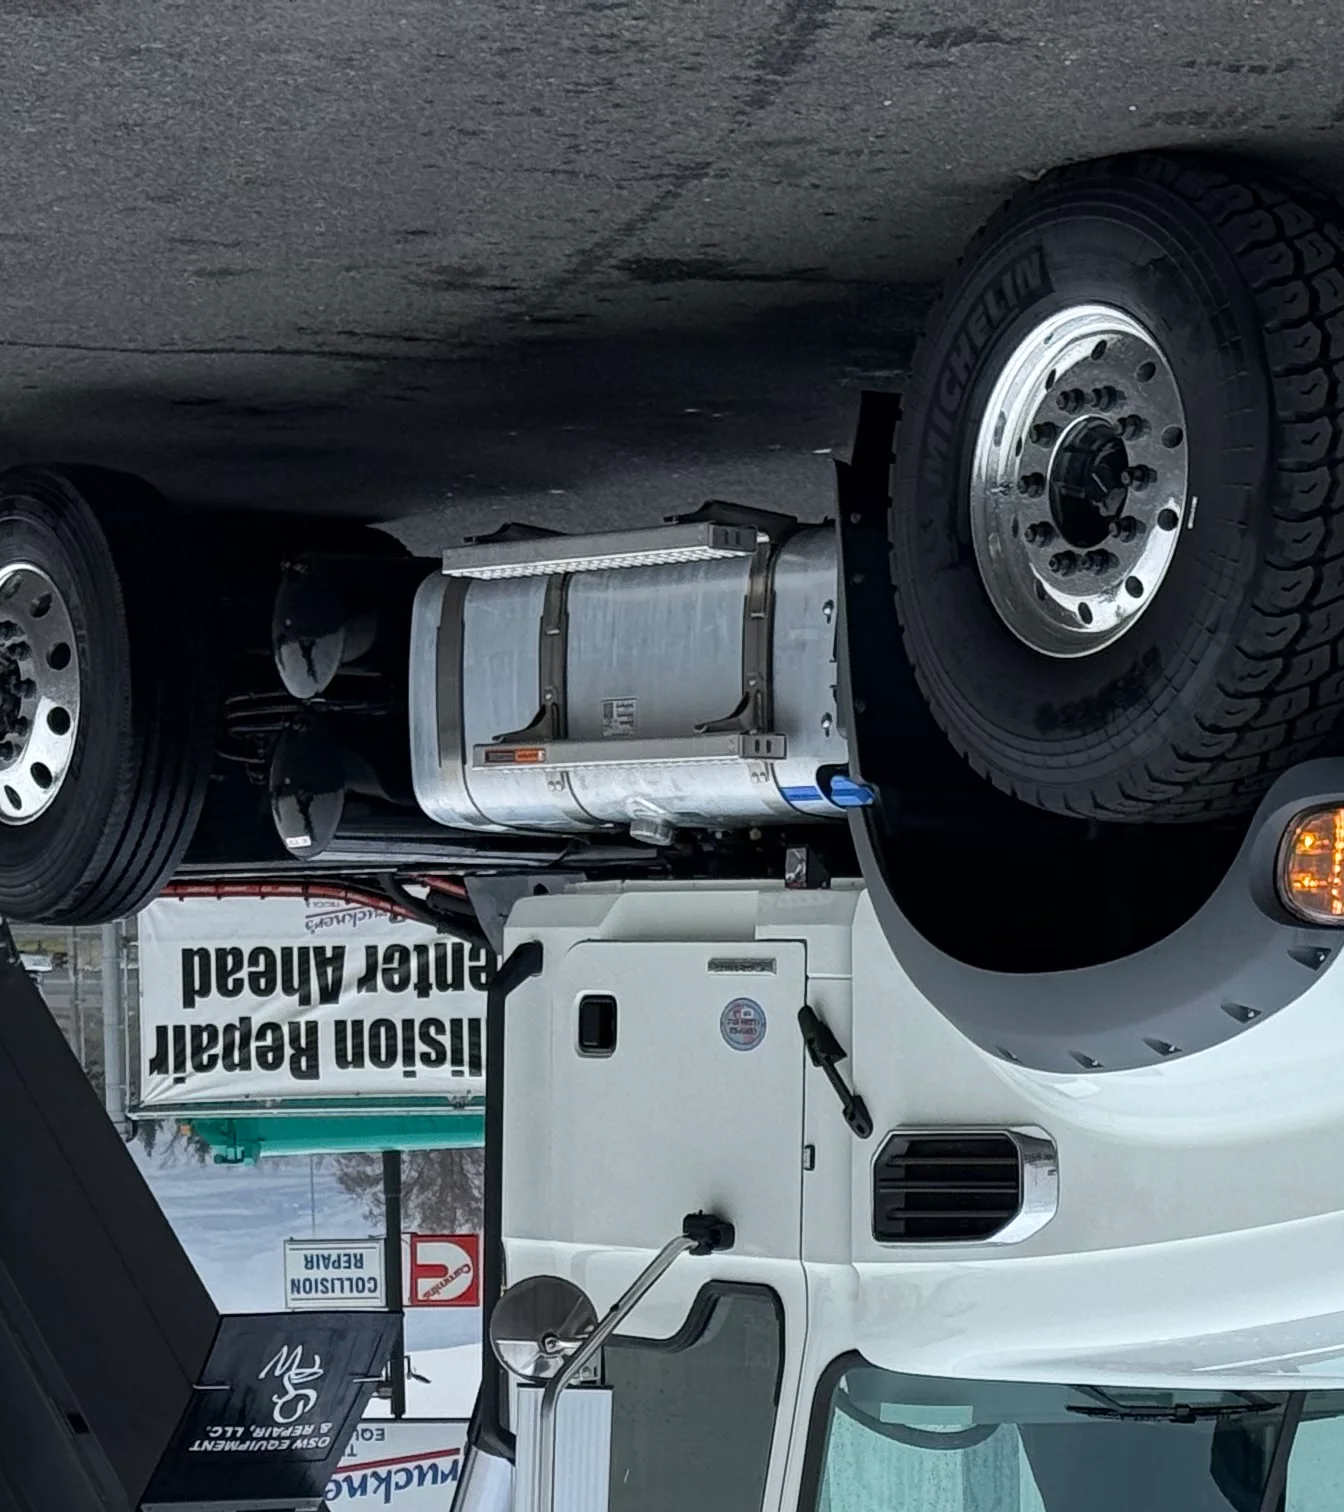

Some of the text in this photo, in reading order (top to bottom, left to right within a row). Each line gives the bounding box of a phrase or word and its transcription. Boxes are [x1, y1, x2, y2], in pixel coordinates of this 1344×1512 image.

[928, 250, 1043, 488] MICHELIN
[180, 945, 346, 1009] Ahead
[148, 1016, 487, 1084] lision Repair
[303, 1253, 364, 1270] REPAIR
[290, 1276, 378, 1295] COLLISION
[422, 1263, 471, 1301] Cummins
[189, 1436, 331, 1452] OSW EQUIPMENT
[205, 1422, 333, 1438] & REPAIR, LLC.
